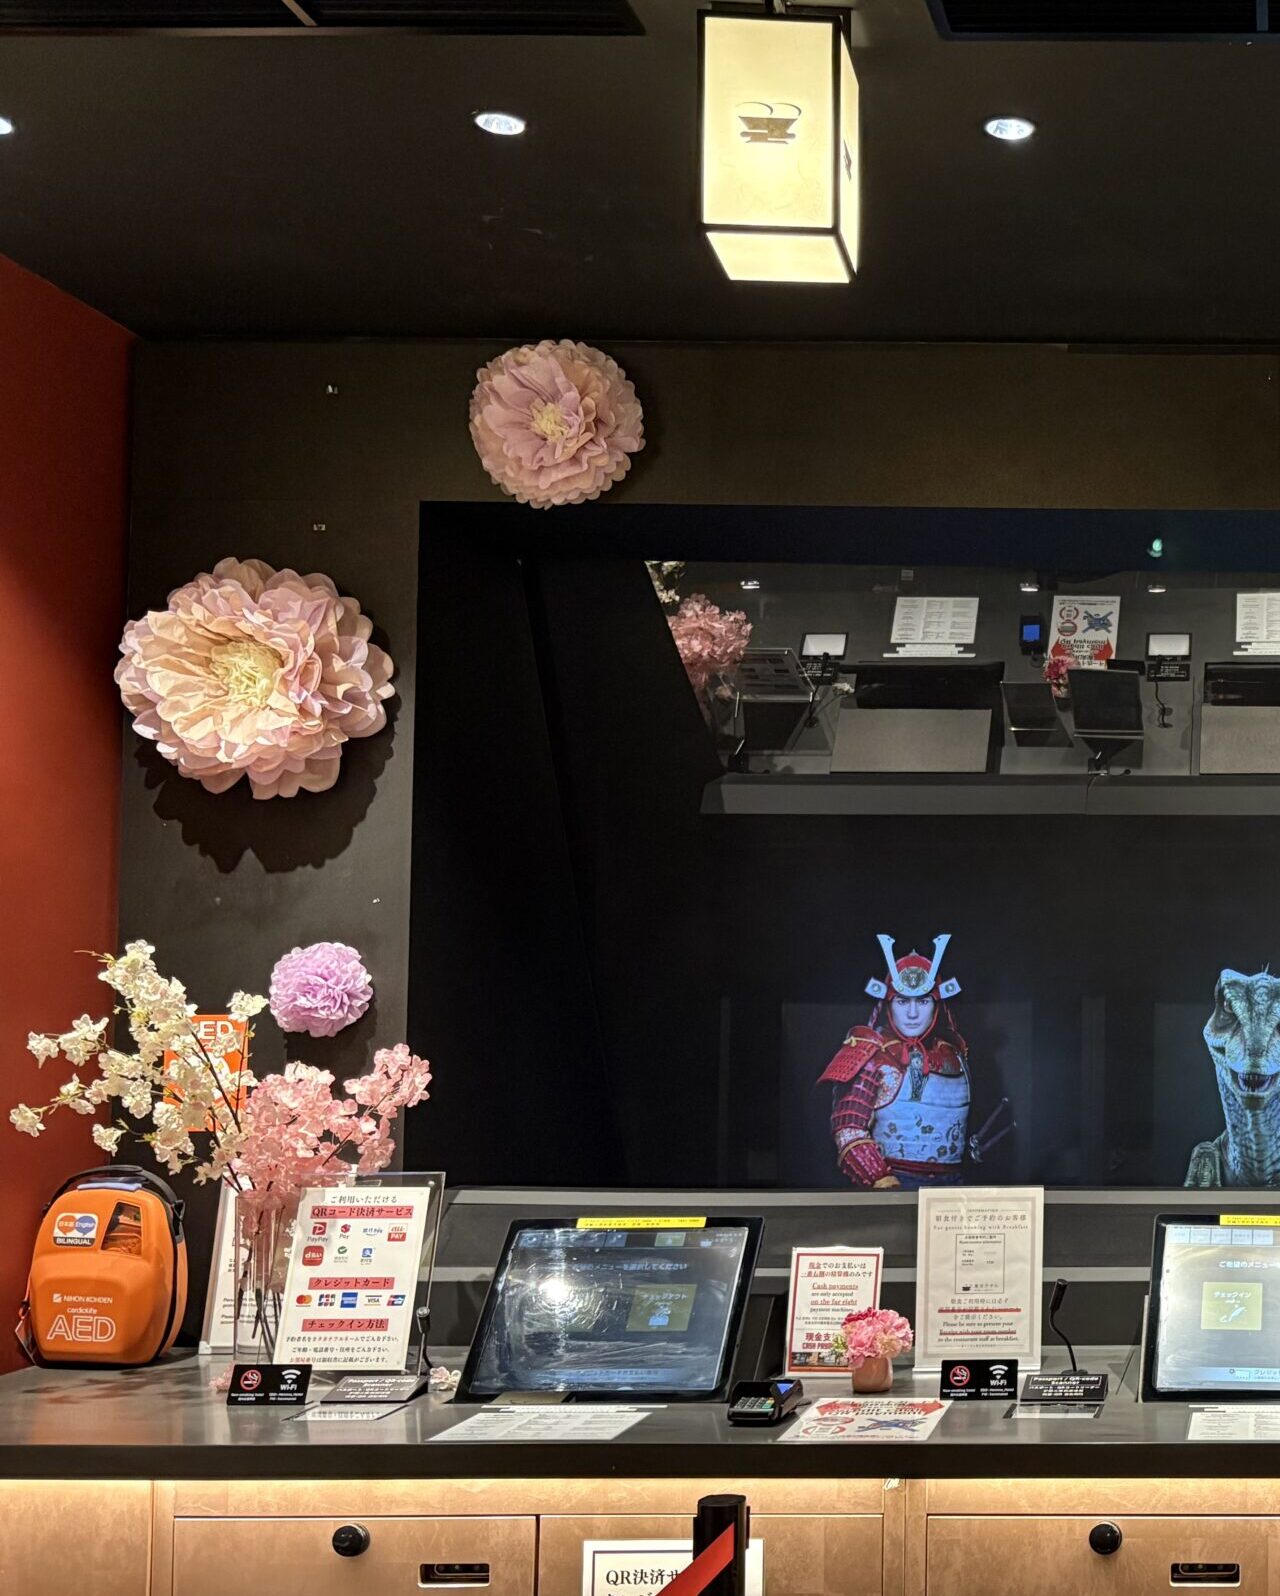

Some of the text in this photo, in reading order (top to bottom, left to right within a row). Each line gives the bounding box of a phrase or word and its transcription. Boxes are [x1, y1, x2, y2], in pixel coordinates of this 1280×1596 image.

[313, 1208, 413, 1217] QRコード決済サービス
[56, 1238, 92, 1246] BILINGUAL
[313, 1278, 390, 1288] クレジットカード
[47, 1315, 117, 1342] AED
[308, 1319, 385, 1329] チェックイン方法
[806, 1333, 831, 1341] 現金支
[606, 1569, 680, 1586] QR決済サ
